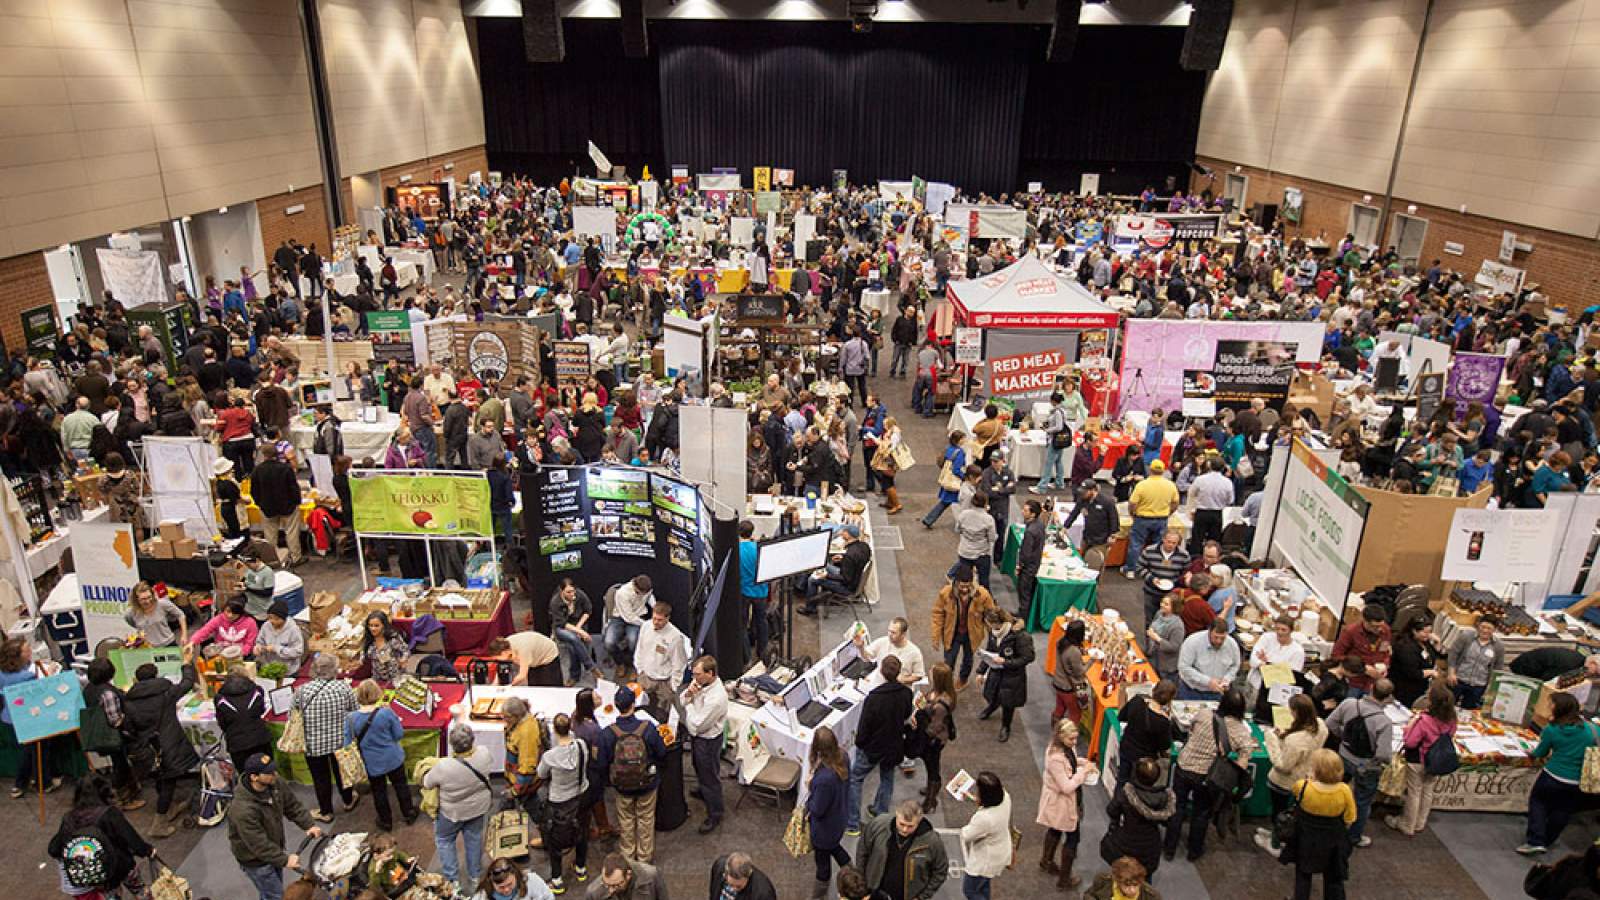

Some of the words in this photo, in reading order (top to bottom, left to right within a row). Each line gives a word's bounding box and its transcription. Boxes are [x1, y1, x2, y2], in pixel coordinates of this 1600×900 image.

[992, 358, 1020, 373] RED
[1023, 352, 1061, 369] MEAT
[1220, 353, 1249, 364] Who's
[1215, 363, 1273, 375] hogging
[1216, 375, 1234, 383] our
[391, 493, 449, 505] THOKKU
